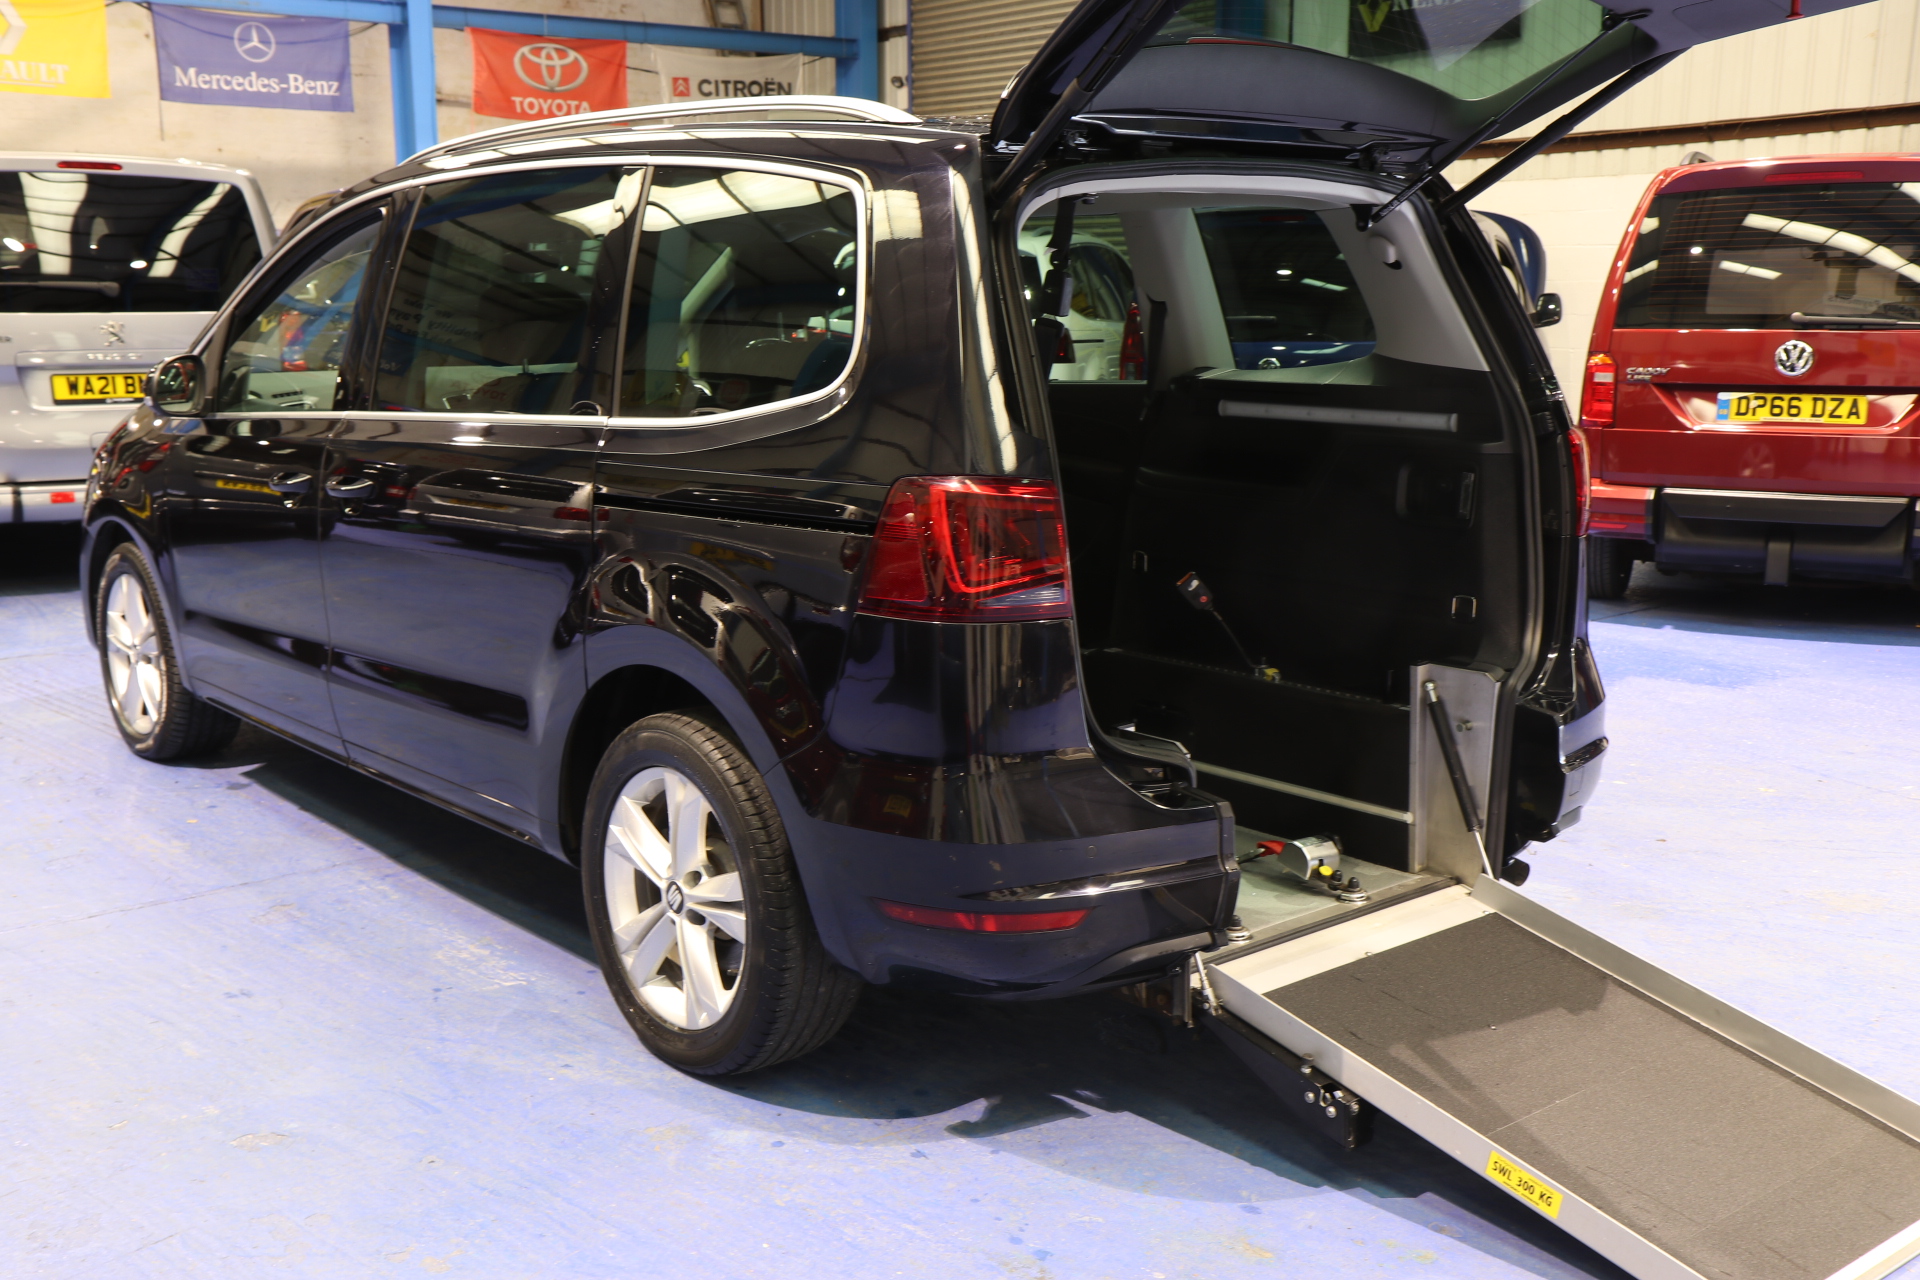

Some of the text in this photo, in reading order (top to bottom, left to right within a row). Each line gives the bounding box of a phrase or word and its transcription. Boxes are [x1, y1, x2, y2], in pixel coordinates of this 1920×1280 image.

[173, 66, 340, 96] Mercedes-Benz
[697, 77, 792, 97] CITROËN
[510, 96, 591, 116] TOYOTA
[66, 375, 117, 396] WA21
[1734, 396, 1861, 419] DP66 DZA
[1491, 1160, 1554, 1207] SWL 300 KG
